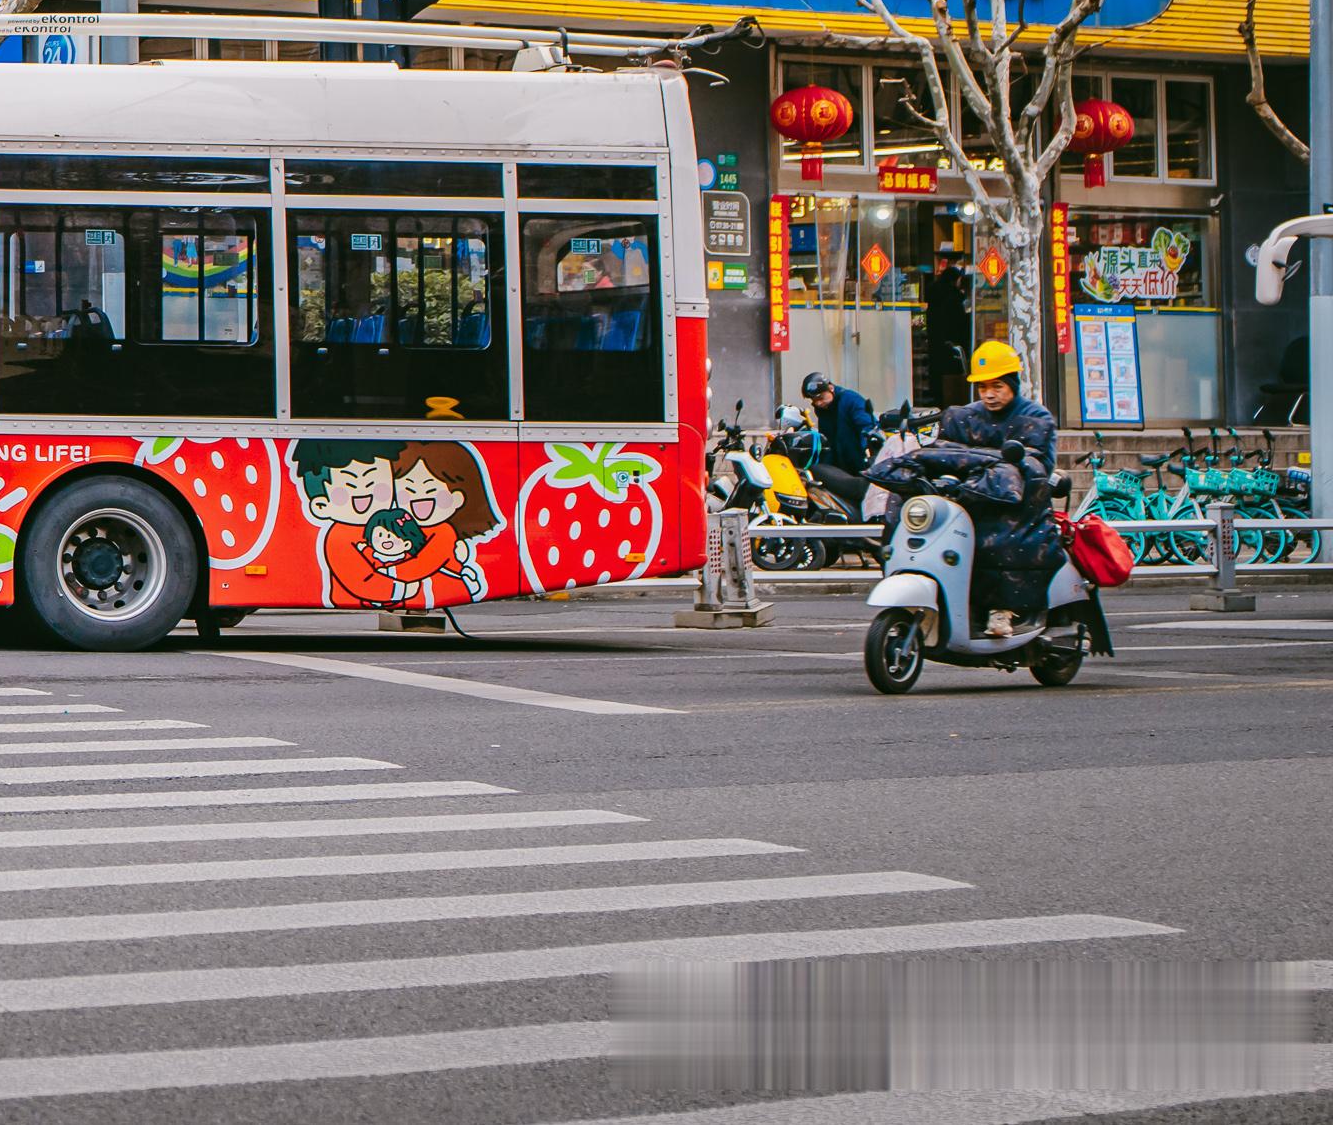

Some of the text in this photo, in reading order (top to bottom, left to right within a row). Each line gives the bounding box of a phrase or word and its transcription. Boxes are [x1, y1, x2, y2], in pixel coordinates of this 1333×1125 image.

[41, 14, 100, 24] eKontrol
[44, 46, 61, 64] 24
[1103, 249, 1162, 274] 源头直采
[1120, 270, 1178, 296] 天天低价
[35, 444, 91, 463] LIFE!
